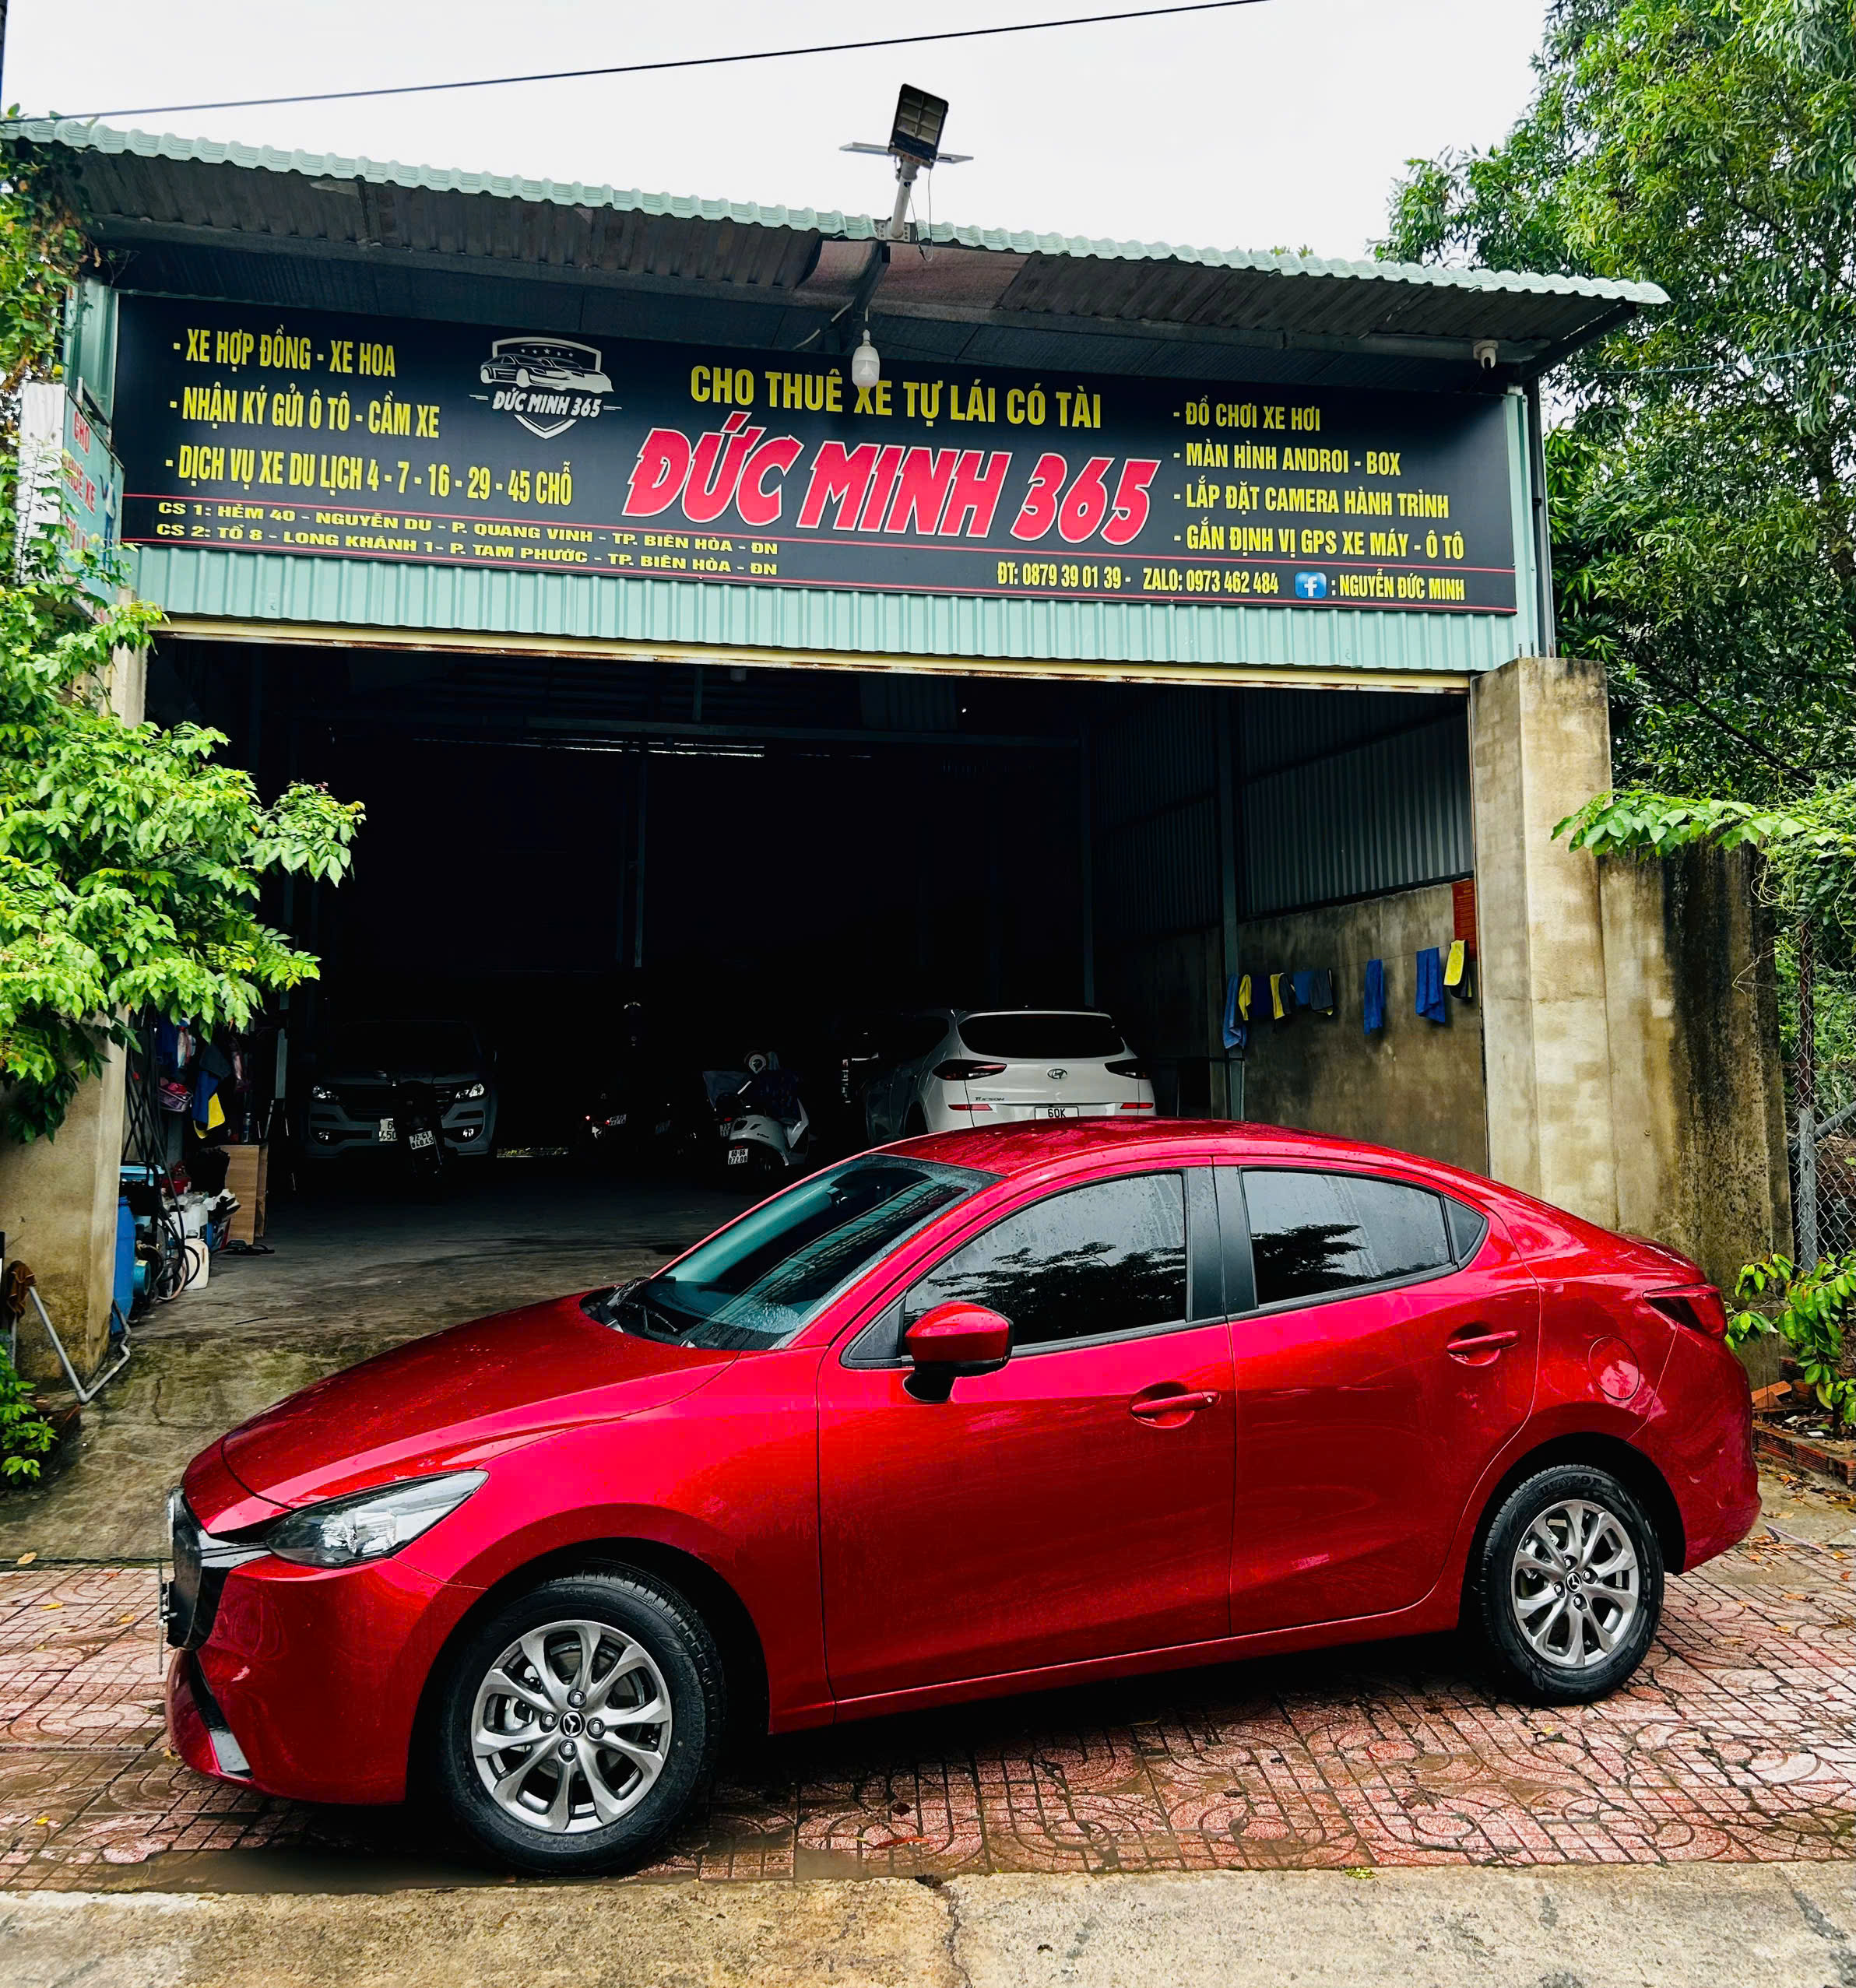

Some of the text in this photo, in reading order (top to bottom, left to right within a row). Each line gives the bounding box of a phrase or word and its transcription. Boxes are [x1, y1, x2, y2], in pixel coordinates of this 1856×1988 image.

[185, 324, 395, 378] XE HỢP ĐỒNG XE HOA
[182, 381, 440, 439] NHẬN KÝ GỬI Ô TÔ CẦM XE
[492, 387, 603, 417] ĐỨC MINH 365
[691, 366, 1101, 429] CHO THUÊ XE TỰ LÁI CÓ TÀI
[1185, 398, 1320, 431] ĐỒ CHƠI XE HƠI
[178, 444, 572, 506] DỊCH VỤ XE DU LỊCH 4 7 16 29 45 CHỖ
[622, 411, 1162, 545] ĐỨC MINH 365
[1186, 438, 1401, 476] MÀN HÌNH ANDROI BOX
[84, 474, 97, 517] XE
[1186, 475, 1450, 518] LẮP ĐẶT CAMERA HÀNH TRÌNH
[156, 523, 185, 536] CS
[190, 525, 212, 538] 2:
[248, 529, 263, 541] 8
[283, 530, 339, 549] LONG
[344, 535, 417, 553] KHÁNH
[450, 542, 467, 555] P.
[472, 543, 515, 560] TAM
[520, 547, 589, 564] PHƯỚC
[606, 553, 634, 567] TP.
[640, 554, 687, 570] BIÊN
[691, 557, 732, 573] HÒA
[750, 561, 778, 575] ĐN
[158, 502, 186, 515] CS
[192, 504, 212, 517] 1:
[269, 508, 296, 522] 40
[315, 511, 399, 529] NGUYỄN
[403, 517, 432, 532] DU
[451, 521, 468, 534] P.
[473, 522, 541, 539] QUANG
[546, 528, 593, 543] VINH
[611, 530, 638, 546] TP.
[644, 533, 689, 550] BIÊN
[694, 536, 733, 553] HÒA
[750, 541, 778, 555] ĐN
[1186, 516, 1464, 560] GẮN ĐỊNH VỊ GPS XE MÁY Ô TÔ
[997, 560, 1279, 595] ĐT: 0879 39 01 39 ZALO: 0973 462 484
[1339, 567, 1465, 601] NGUYỄN ĐỨC MINH
